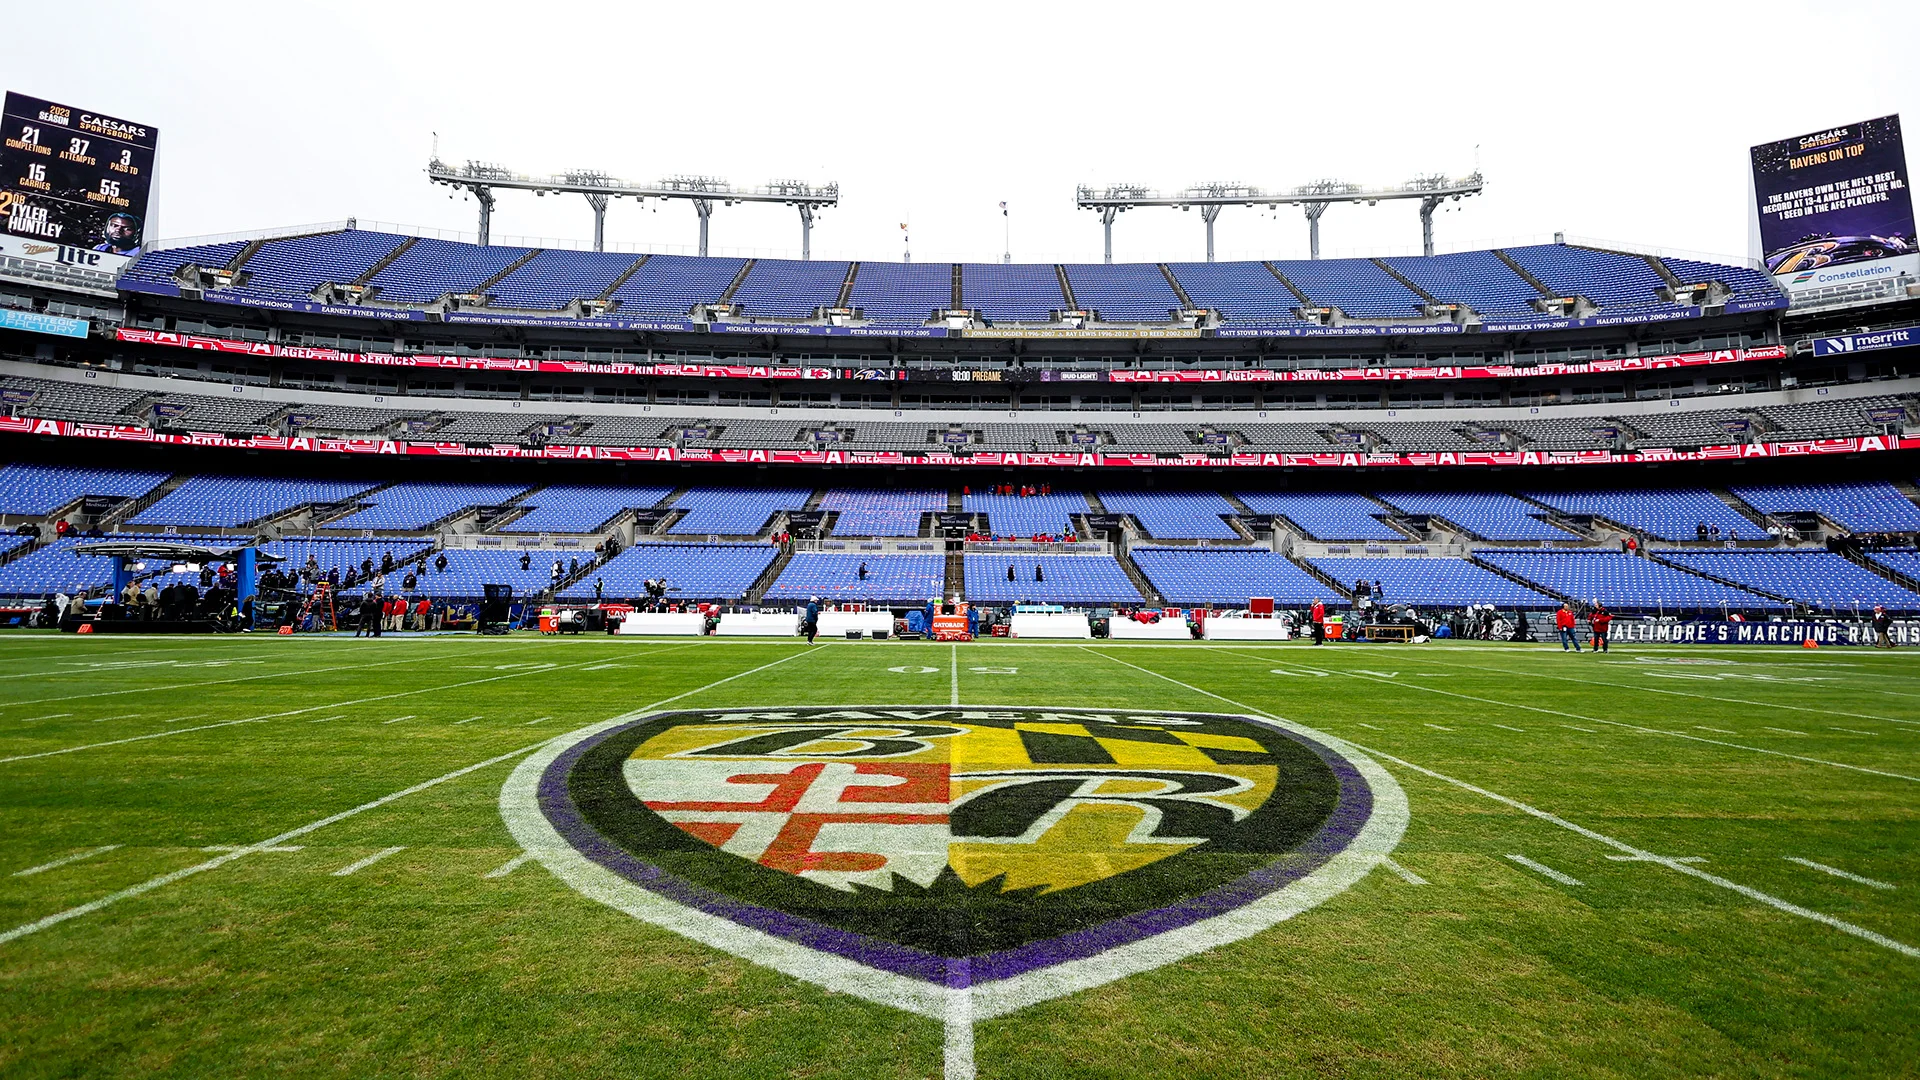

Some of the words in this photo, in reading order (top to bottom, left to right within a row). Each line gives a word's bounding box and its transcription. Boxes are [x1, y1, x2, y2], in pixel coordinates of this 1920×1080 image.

[39, 111, 70, 126] SEASON
[50, 106, 70, 118] 2023
[80, 114, 146, 137] CAESARS
[80, 122, 134, 140] SPORTSBOOK
[22, 126, 40, 145] 21
[1799, 128, 1848, 144] CAESARS
[1800, 137, 1840, 150] SPORTSBOOK
[6, 138, 52, 156] COMPLETIONS
[70, 138, 90, 156] 37
[59, 150, 96, 166] ATTEMPTS
[120, 150, 132, 166] 3
[1790, 152, 1828, 170] RAVENS
[1829, 148, 1844, 162] ON
[1844, 144, 1864, 158] TOP
[28, 163, 46, 182] 15
[110, 162, 128, 174] PASS
[129, 166, 138, 175] TD
[20, 178, 51, 190] CARRIES
[100, 179, 120, 197] 55
[1768, 194, 1782, 204] THE
[1784, 188, 1814, 202] RAVENS
[1815, 185, 1834, 196] OWN
[1835, 181, 1850, 192] THE
[1851, 176, 1874, 190] NFL'S
[1875, 170, 1896, 183] BEST
[87, 191, 106, 203] RUSH
[107, 194, 130, 207] YARDS
[1762, 202, 1792, 214] RECORD
[1794, 200, 1804, 210] AT
[1805, 196, 1822, 207] 13-4
[1823, 192, 1840, 203] AND
[1840, 186, 1872, 200] EARNED
[1873, 182, 1888, 194] THE
[1890, 179, 1905, 190] NO.
[12, 202, 48, 222] TYLER
[1778, 212, 1783, 220] 1
[1784, 208, 1804, 220] SEED
[1804, 206, 1814, 216] IN
[1814, 204, 1830, 214] THE
[1830, 200, 1846, 211] AFC
[1846, 192, 1890, 208] PLAYOFFS.
[8, 216, 63, 238] HUNTLEY
[55, 244, 100, 266] Lite
[1818, 264, 1892, 283] Constellation
[240, 298, 260, 306] RING
[264, 300, 293, 310] HONOR
[322, 306, 351, 316] EARNEST
[352, 309, 374, 318] BYNER
[376, 311, 410, 320] 1996-2003
[6, 312, 78, 328] STRATEGIC
[1596, 317, 1622, 325] HALOTI
[1624, 315, 1648, 323] NGATA
[1649, 311, 1690, 321] 2006-2014
[6, 319, 76, 334] FACTORY
[1856, 330, 1910, 346] merritt
[1857, 342, 1892, 350] COMPANIES
[360, 353, 417, 365] SERVICES
[952, 370, 971, 381] 90:00
[972, 371, 1001, 382] PREGAME
[550, 619, 557, 628] G
[1325, 626, 1332, 634] G
[1738, 626, 1837, 641] MARCHING
[704, 709, 1203, 726] RAVENS
